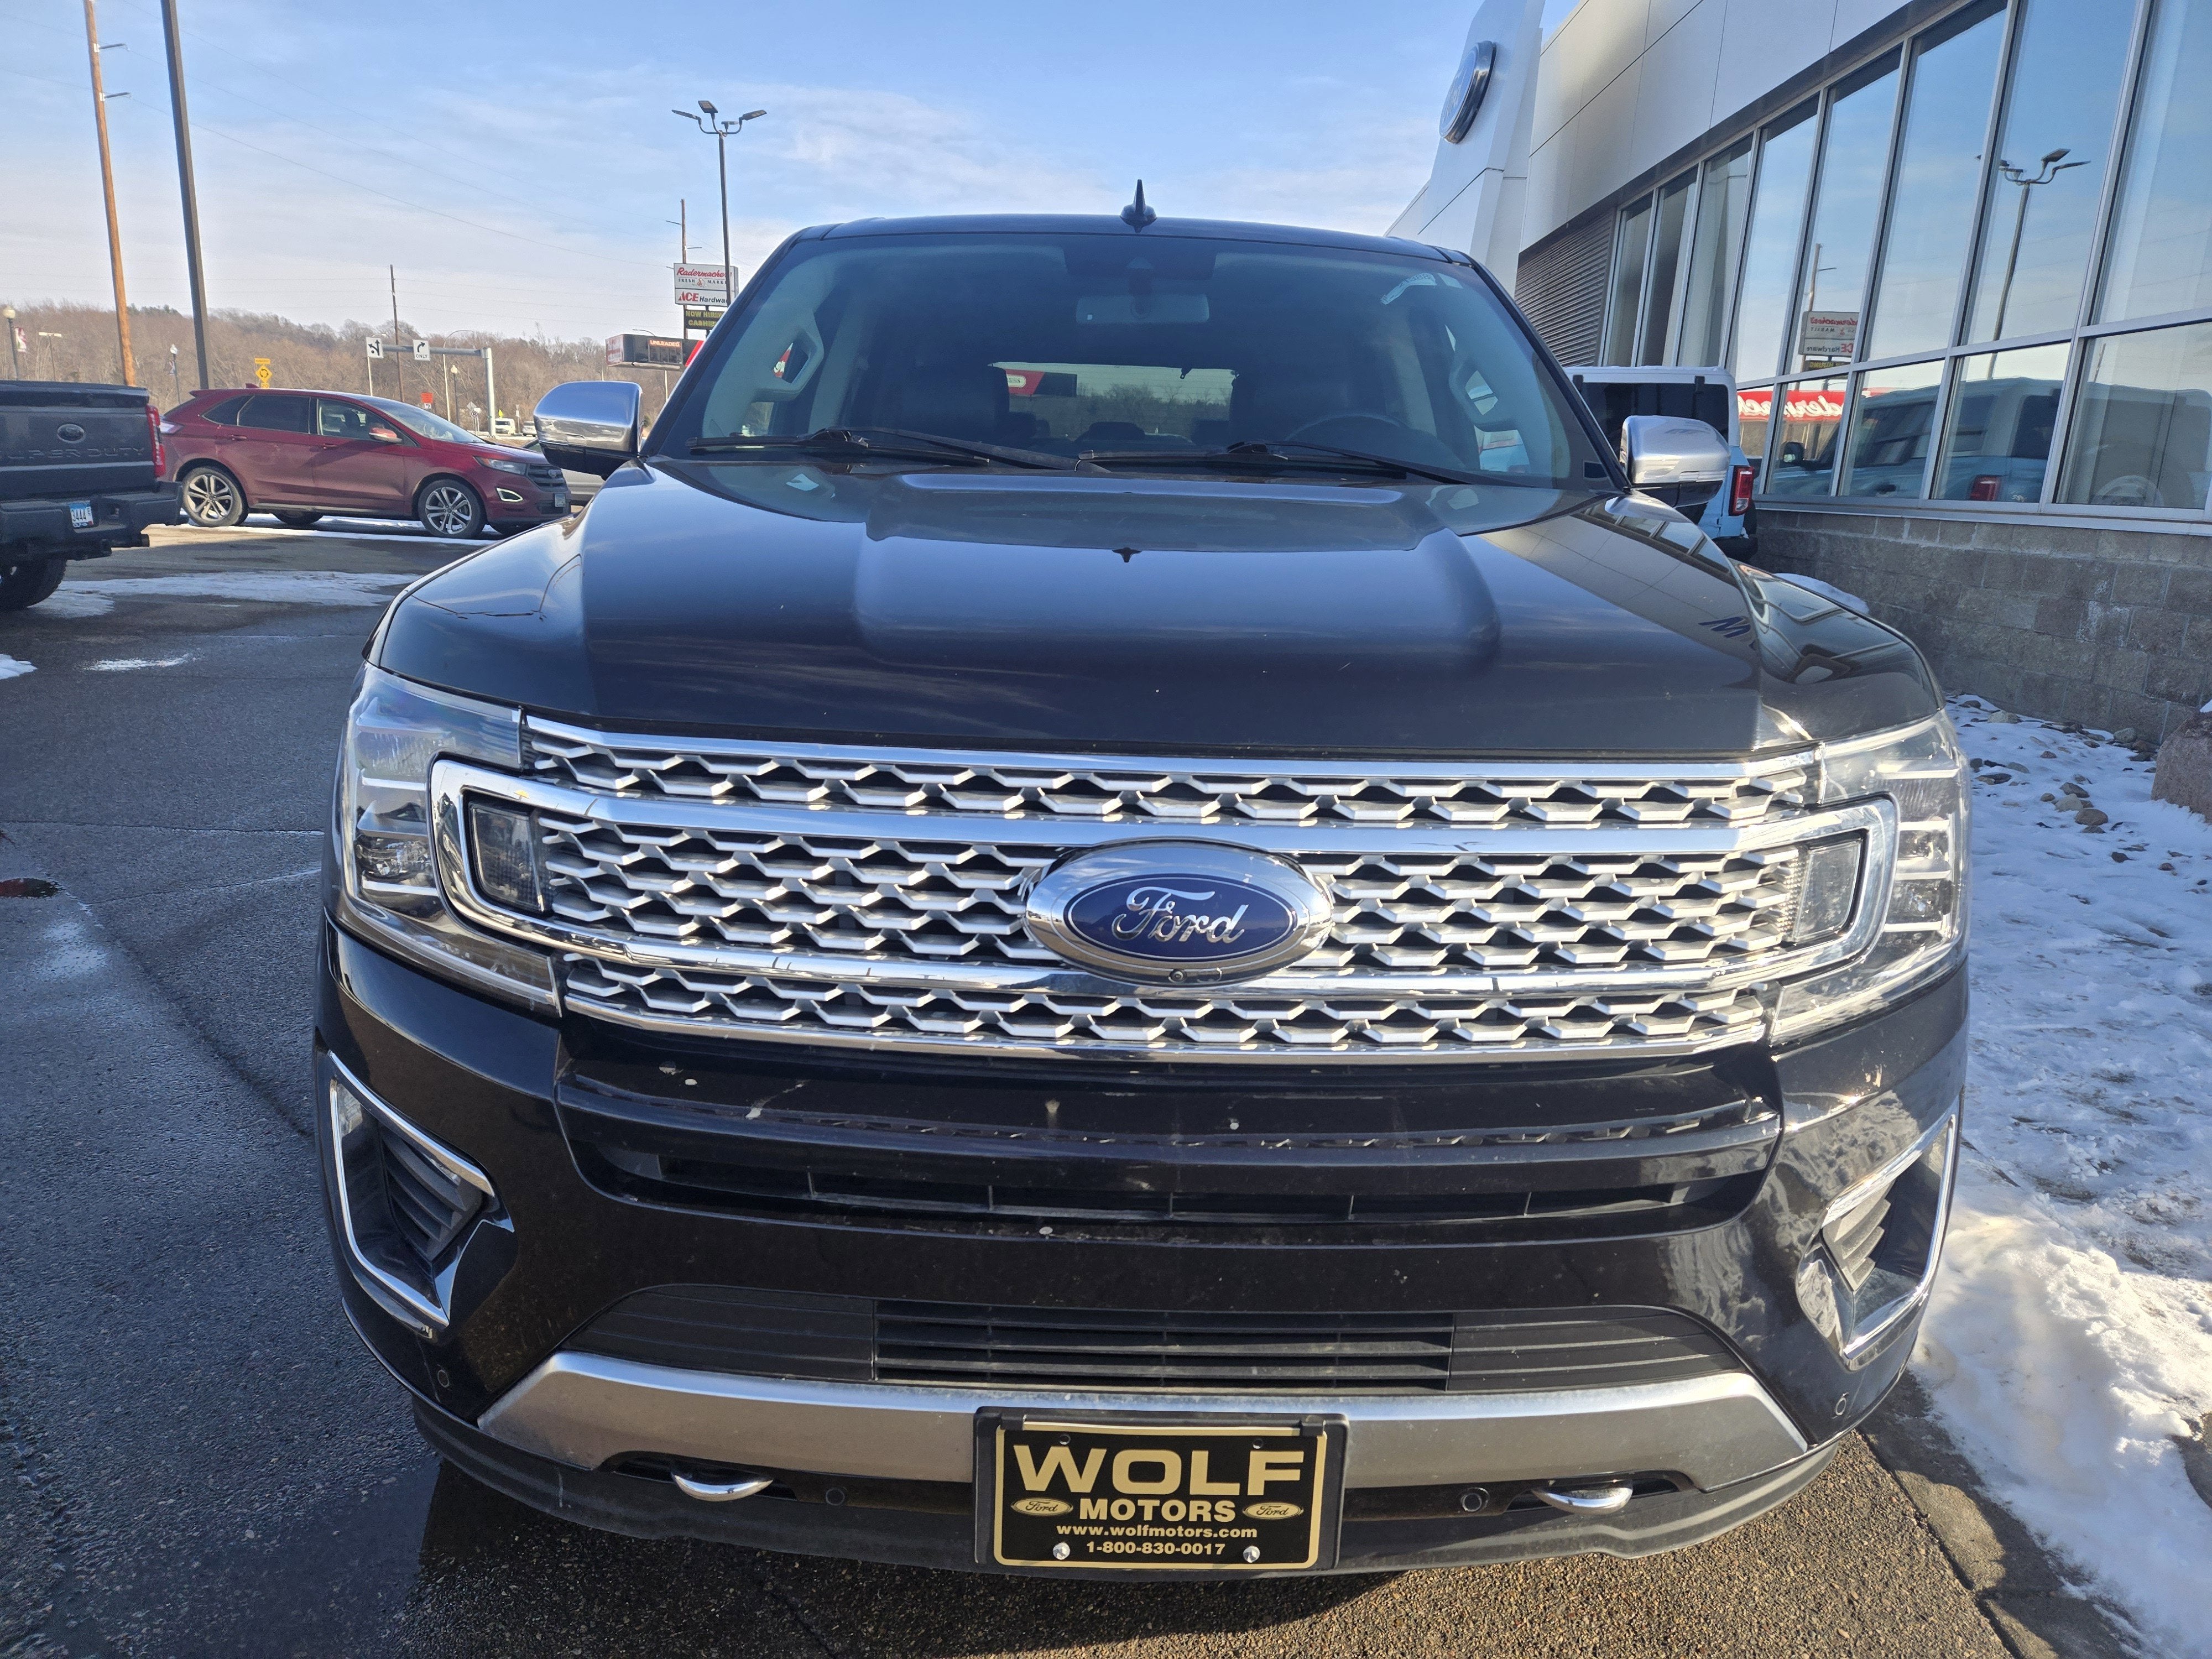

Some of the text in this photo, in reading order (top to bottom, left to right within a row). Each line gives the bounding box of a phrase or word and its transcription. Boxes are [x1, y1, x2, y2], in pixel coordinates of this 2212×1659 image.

[678, 291, 699, 302] ACE
[0, 447, 145, 460] UPER DUTY
[71, 508, 87, 521] 3444
[1111, 886, 1249, 944] Ford
[1013, 1444, 1304, 1496] WOLF
[1025, 1501, 1059, 1512] Ford
[1078, 1498, 1236, 1522] MOTORS
[1256, 1505, 1290, 1516] Ford
[1056, 1524, 1258, 1538] www.wolfmotors.com
[1086, 1541, 1225, 1555] 1-800-830-0017
